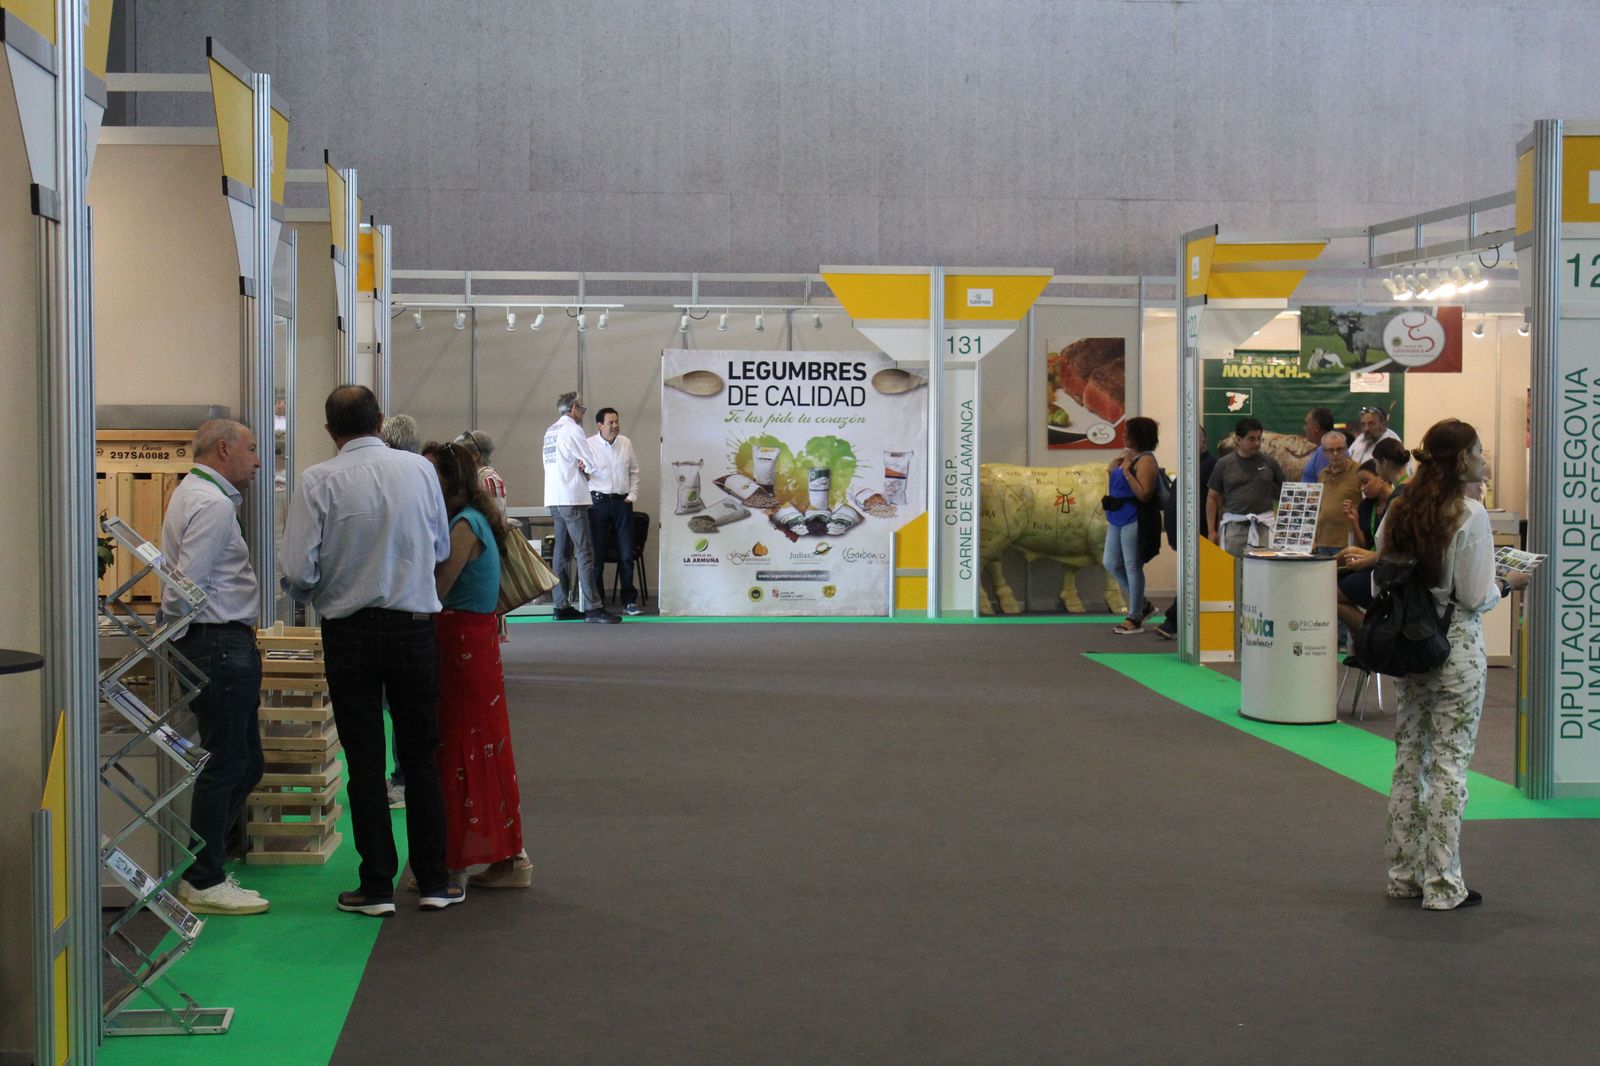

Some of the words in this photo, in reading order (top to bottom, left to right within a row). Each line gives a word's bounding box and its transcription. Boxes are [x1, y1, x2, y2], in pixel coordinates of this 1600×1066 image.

[947, 336, 982, 354] 131
[728, 361, 867, 381] LEGUMBRES
[728, 385, 759, 406] DE
[765, 385, 866, 407] CALIDAD
[724, 409, 744, 423] Te
[745, 412, 763, 423] las
[763, 412, 794, 428] pide
[798, 413, 811, 423] tu
[815, 413, 866, 429] corazón
[1563, 367, 1588, 498] SEGOVIA
[110, 451, 170, 460] 297SA0082
[960, 400, 973, 497] SALAMANCA
[945, 455, 958, 526] C.R.I.G.P.
[960, 502, 972, 521] DE
[1562, 509, 1585, 546] DE
[959, 527, 972, 580] CARNE
[1556, 559, 1585, 739] DIPUTACIÓN
